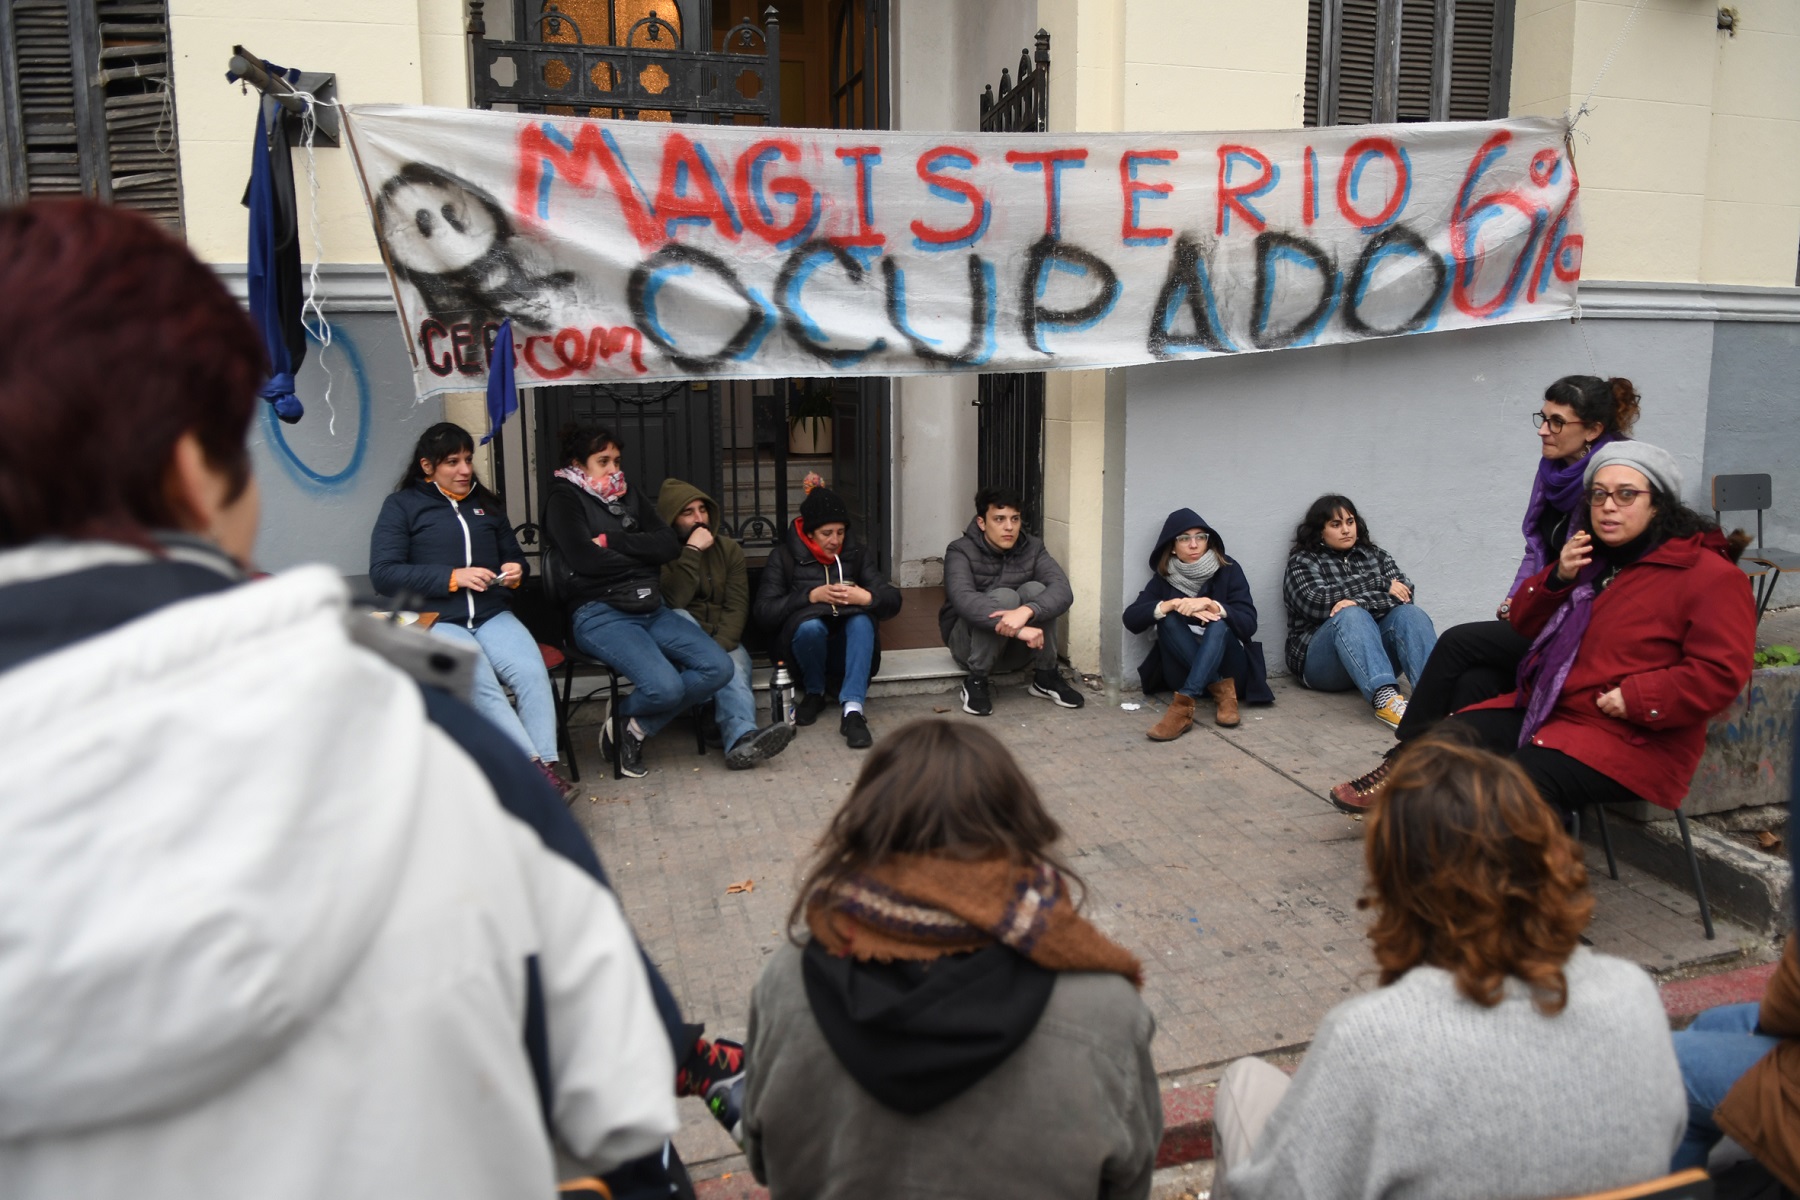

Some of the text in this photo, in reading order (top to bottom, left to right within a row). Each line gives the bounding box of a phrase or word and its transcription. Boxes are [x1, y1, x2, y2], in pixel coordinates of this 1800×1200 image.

[516, 119, 1411, 254] MAGISTERIO
[1449, 128, 1584, 319] 6%
[627, 236, 1452, 373] OCUPADO
